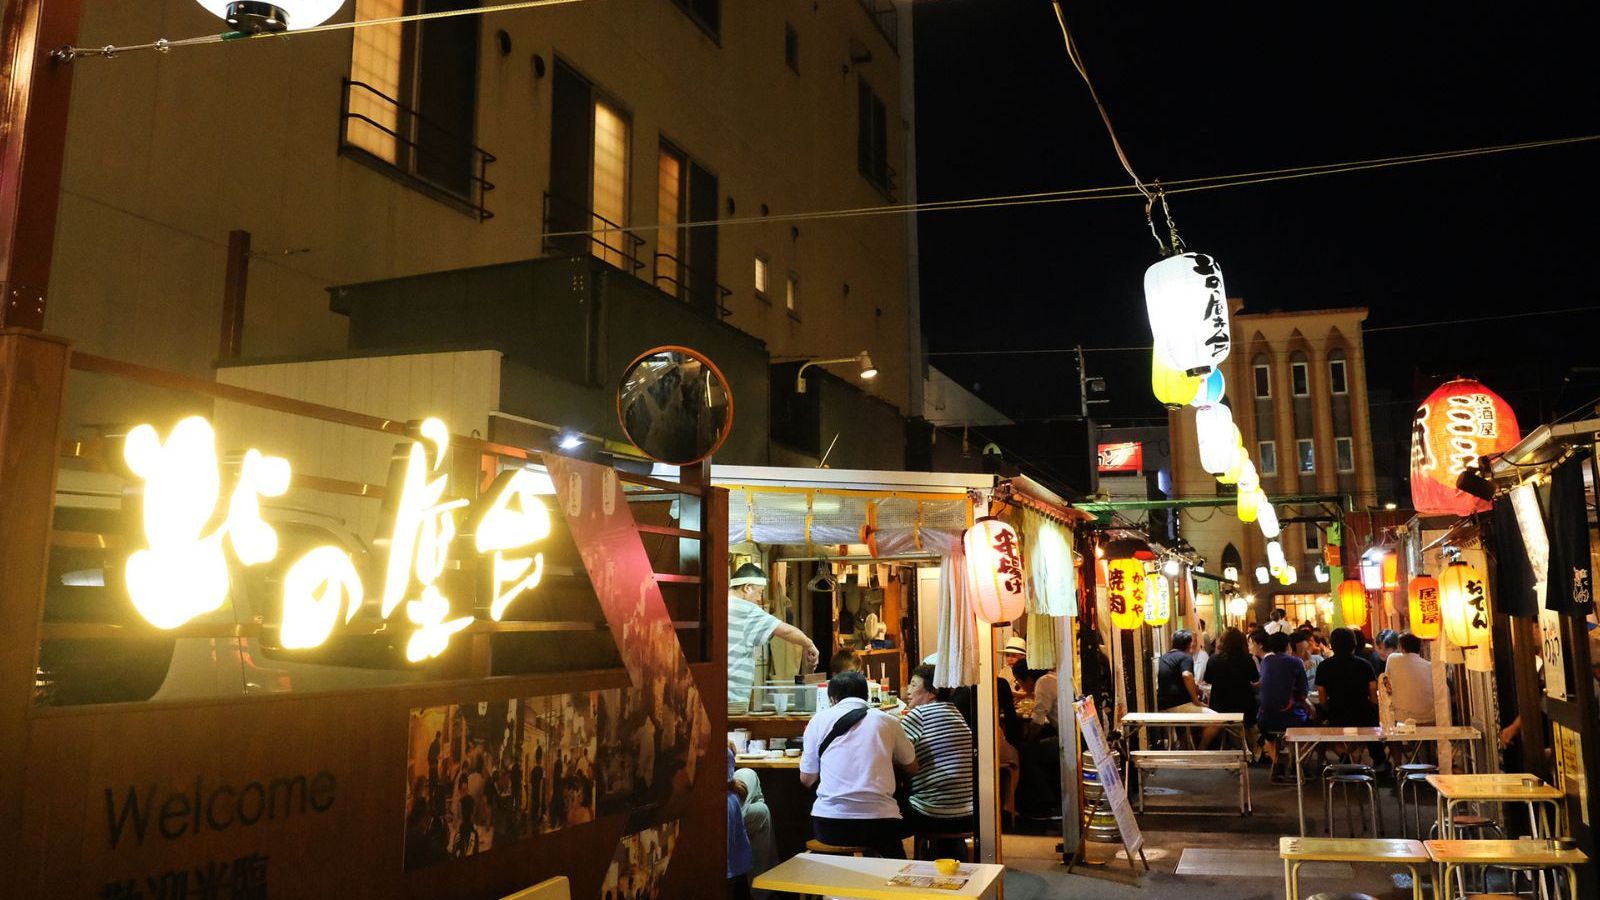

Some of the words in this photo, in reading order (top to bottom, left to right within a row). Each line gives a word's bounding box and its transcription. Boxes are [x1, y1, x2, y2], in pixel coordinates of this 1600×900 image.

[1474, 395, 1495, 436] 居酒屋
[993, 528, 1022, 594] 串揚げ
[1109, 568, 1127, 614] 焼肉
[1131, 571, 1144, 617] かなや
[1419, 588, 1439, 624] 居酒屋
[104, 769, 337, 850] Welcome
